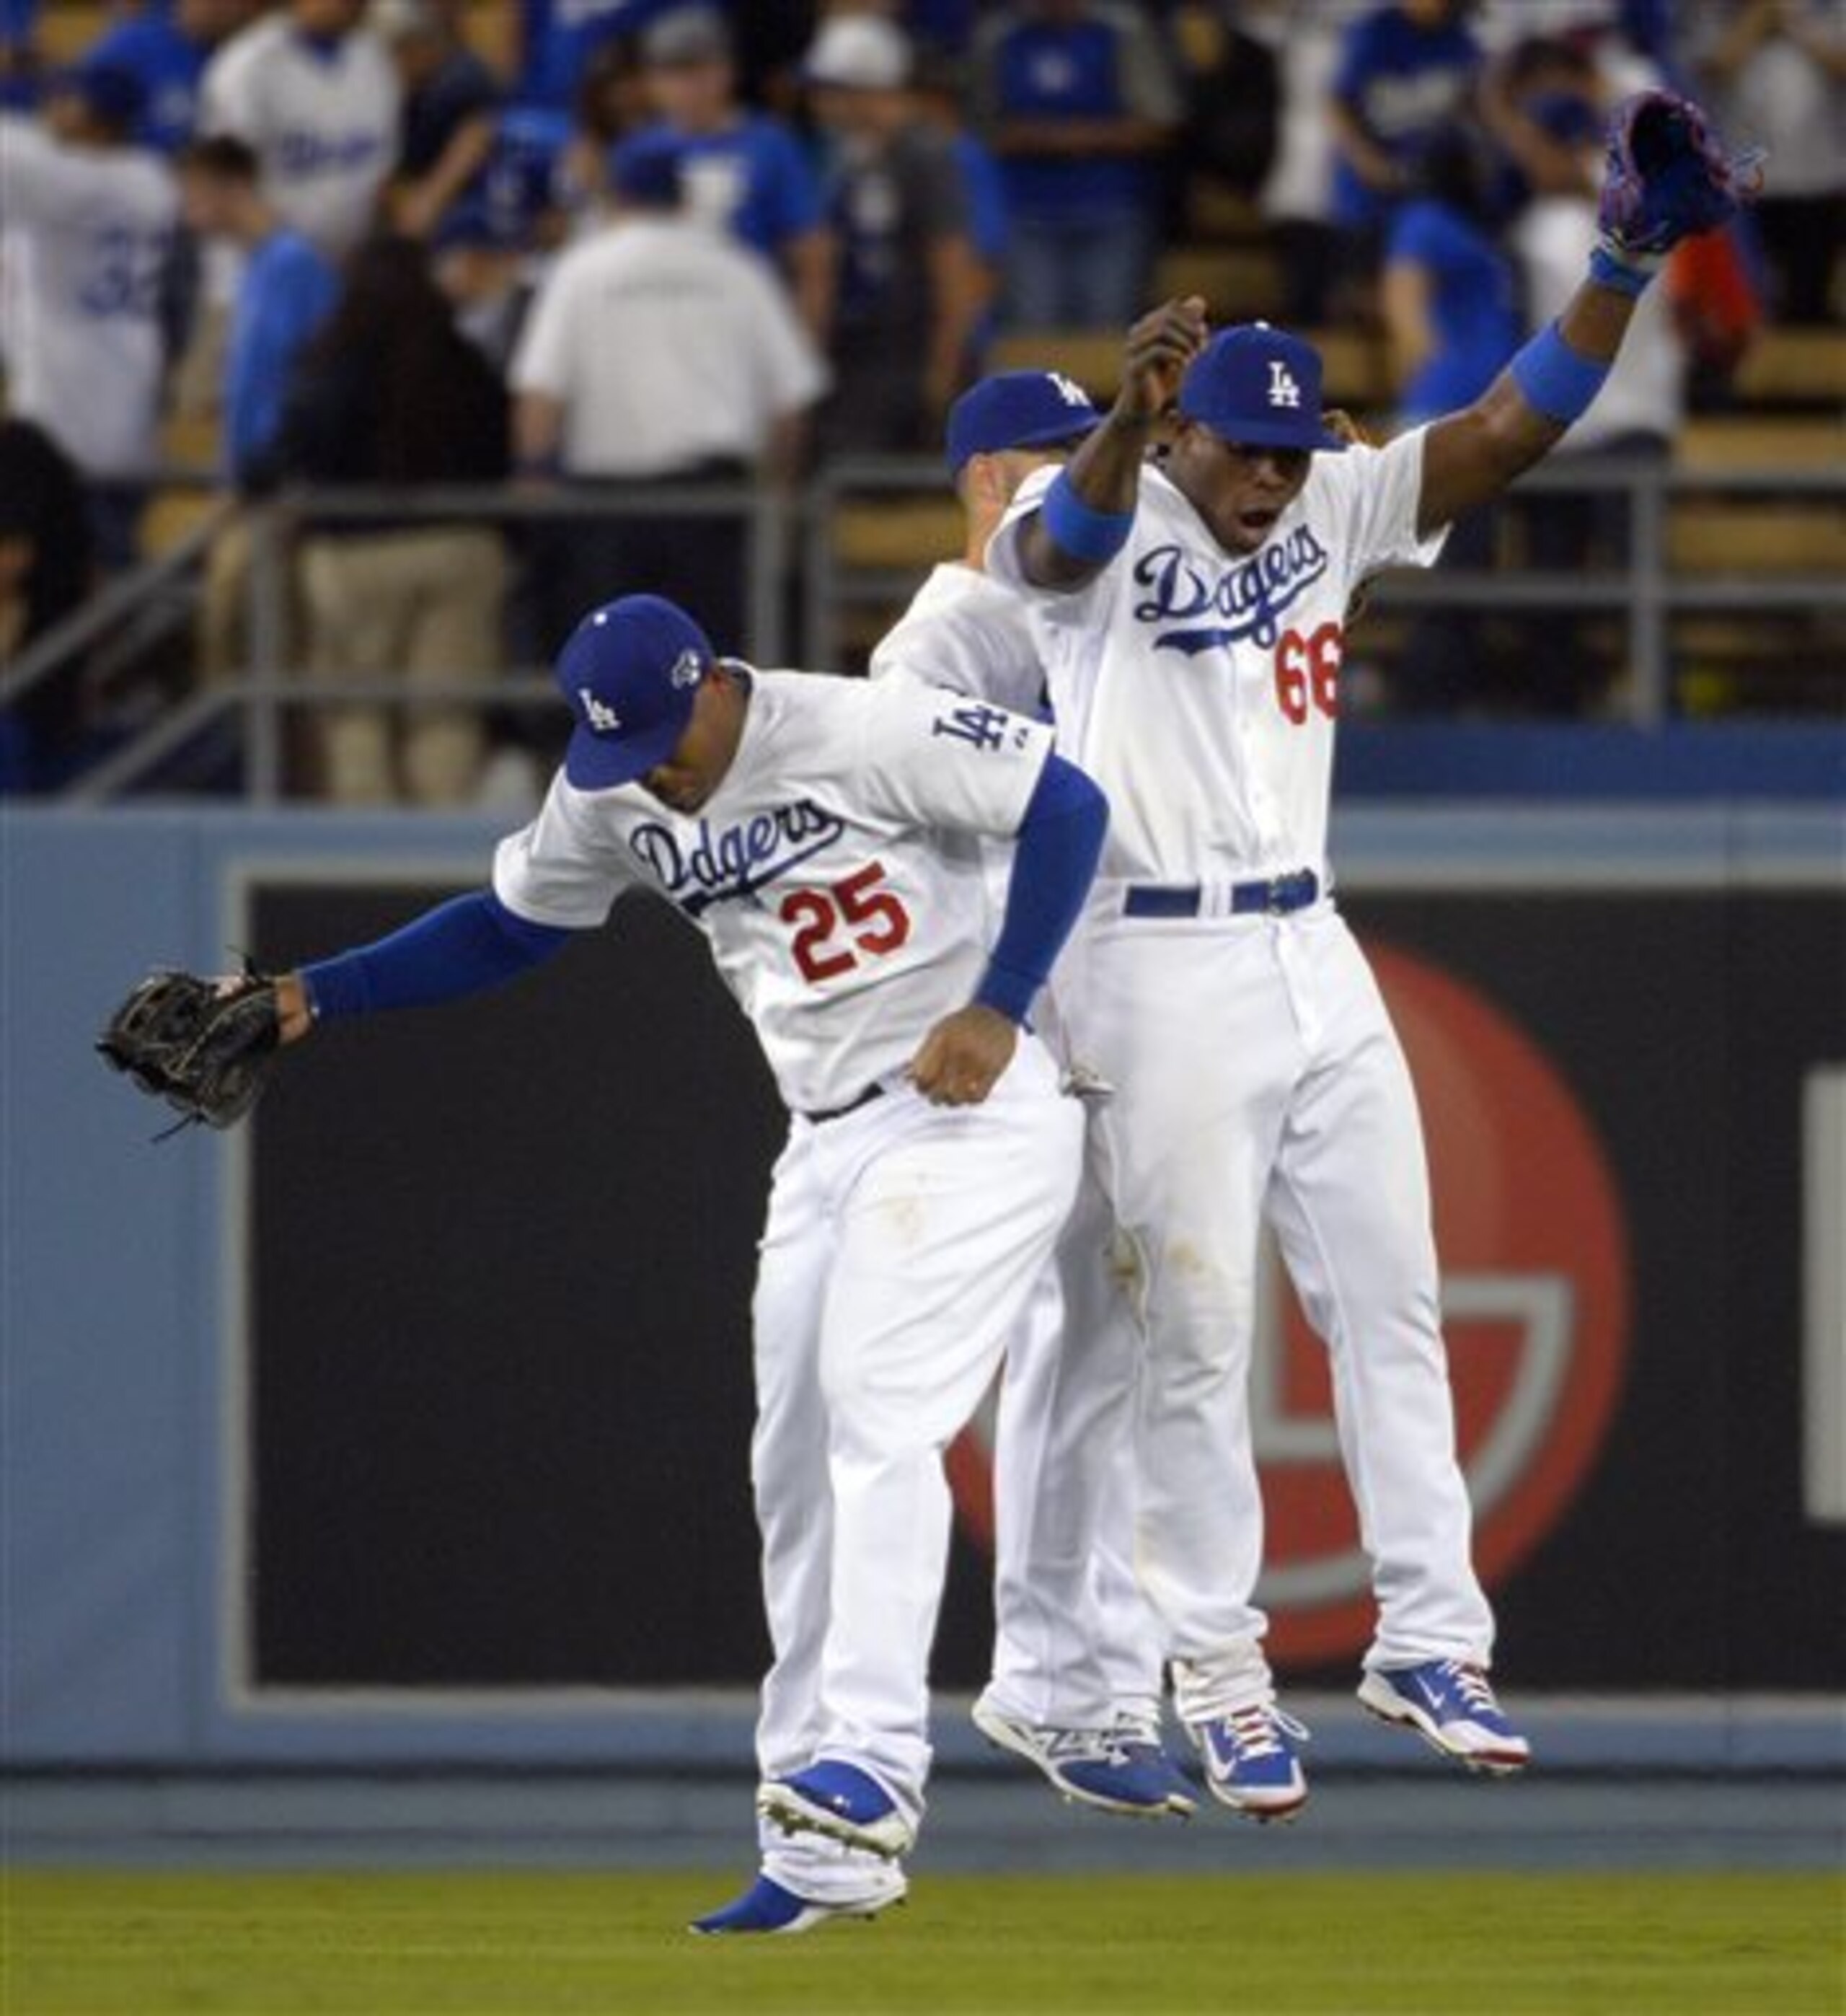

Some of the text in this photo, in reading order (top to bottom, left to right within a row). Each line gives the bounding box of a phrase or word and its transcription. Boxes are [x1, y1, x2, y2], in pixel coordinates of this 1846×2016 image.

[1267, 361, 1300, 408] LA
[1274, 622, 1340, 725] 66
[580, 688, 620, 731] LA
[932, 703, 1007, 751] LA
[780, 860, 909, 984] 25
